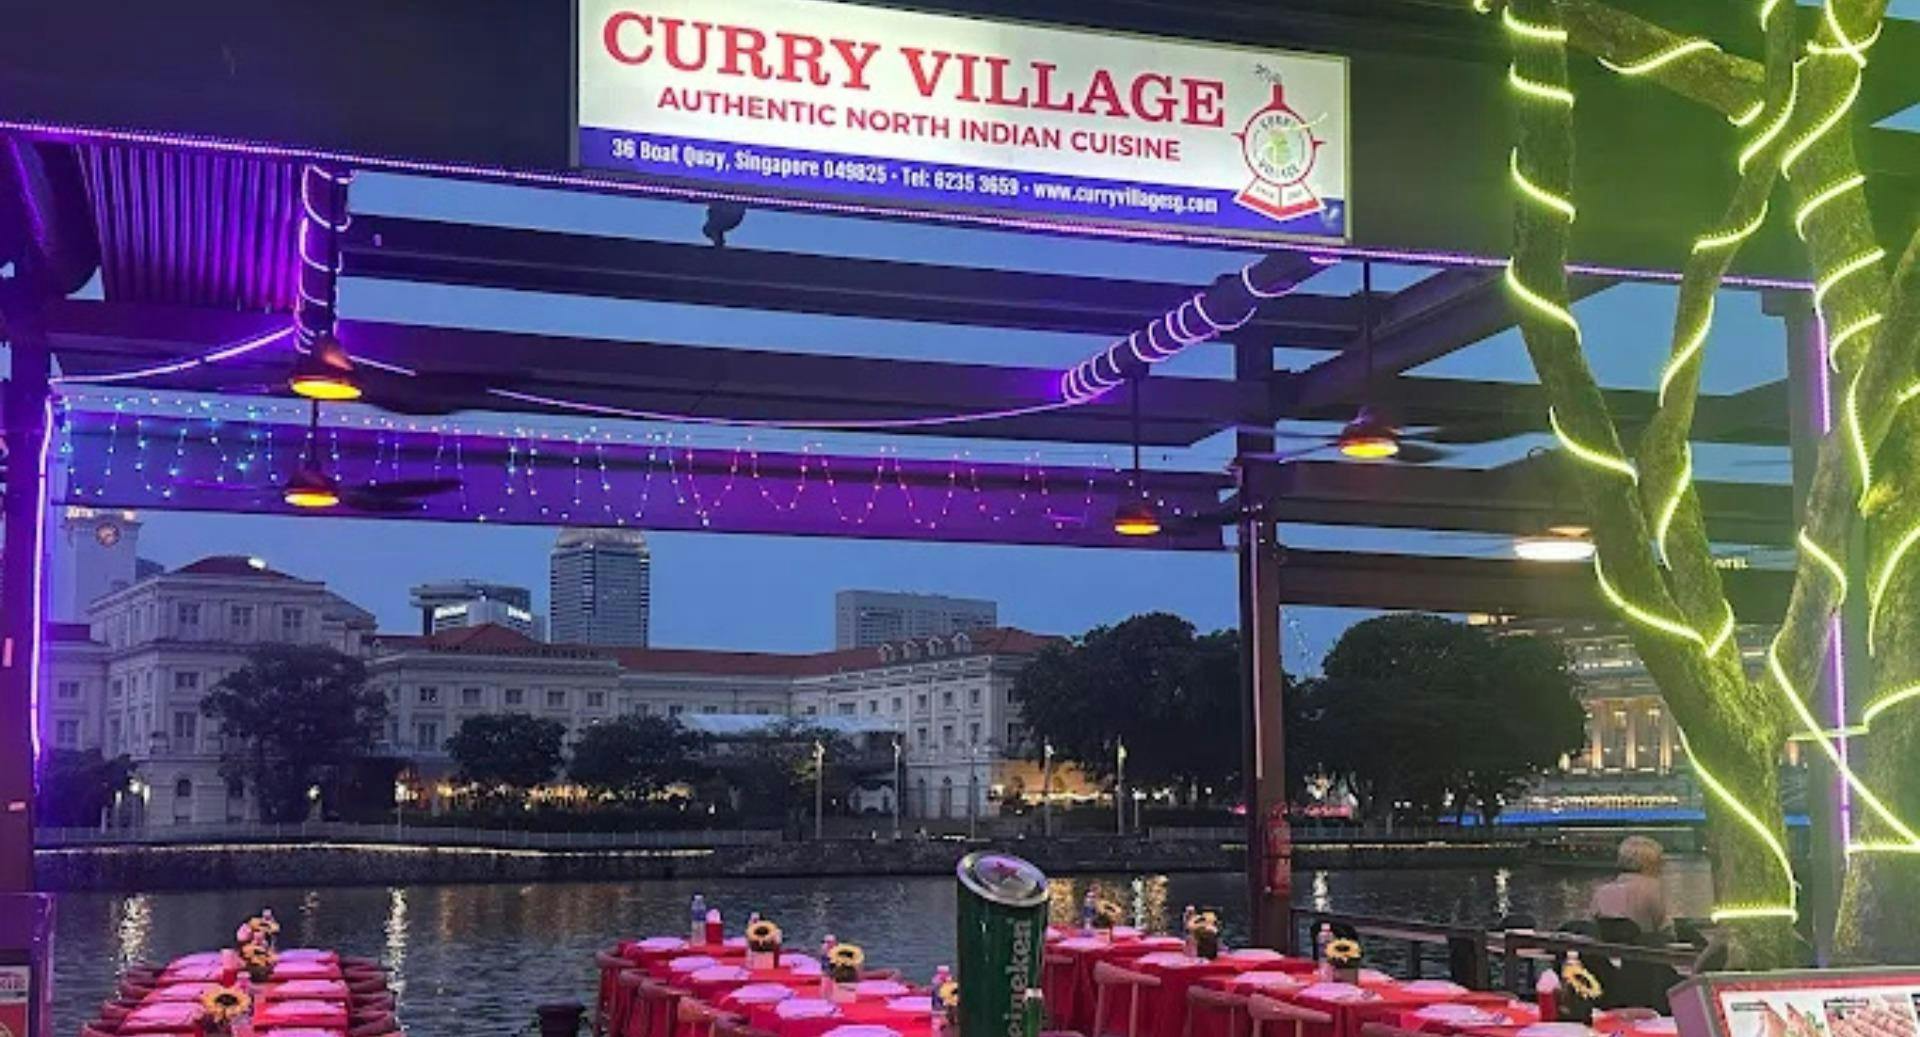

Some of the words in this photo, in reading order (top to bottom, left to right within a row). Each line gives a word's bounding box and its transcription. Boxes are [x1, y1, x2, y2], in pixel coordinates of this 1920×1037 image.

[603, 11, 881, 91] CURRY
[898, 46, 1225, 128] VILLAGE
[657, 86, 837, 126] AUTHENTIC
[846, 107, 950, 138] NORTH
[960, 118, 1061, 150] INDIAN
[1070, 131, 1181, 161] CUISINE
[612, 138, 635, 160] 36
[640, 140, 678, 162] Boat
[683, 145, 731, 173] Quay,
[734, 151, 819, 178] Singapore
[823, 160, 887, 184] 049825
[902, 166, 931, 188] Tel:
[934, 170, 974, 193] 6235
[978, 174, 1020, 197] 3659
[1033, 180, 1218, 214] www.curryvillagesg.com
